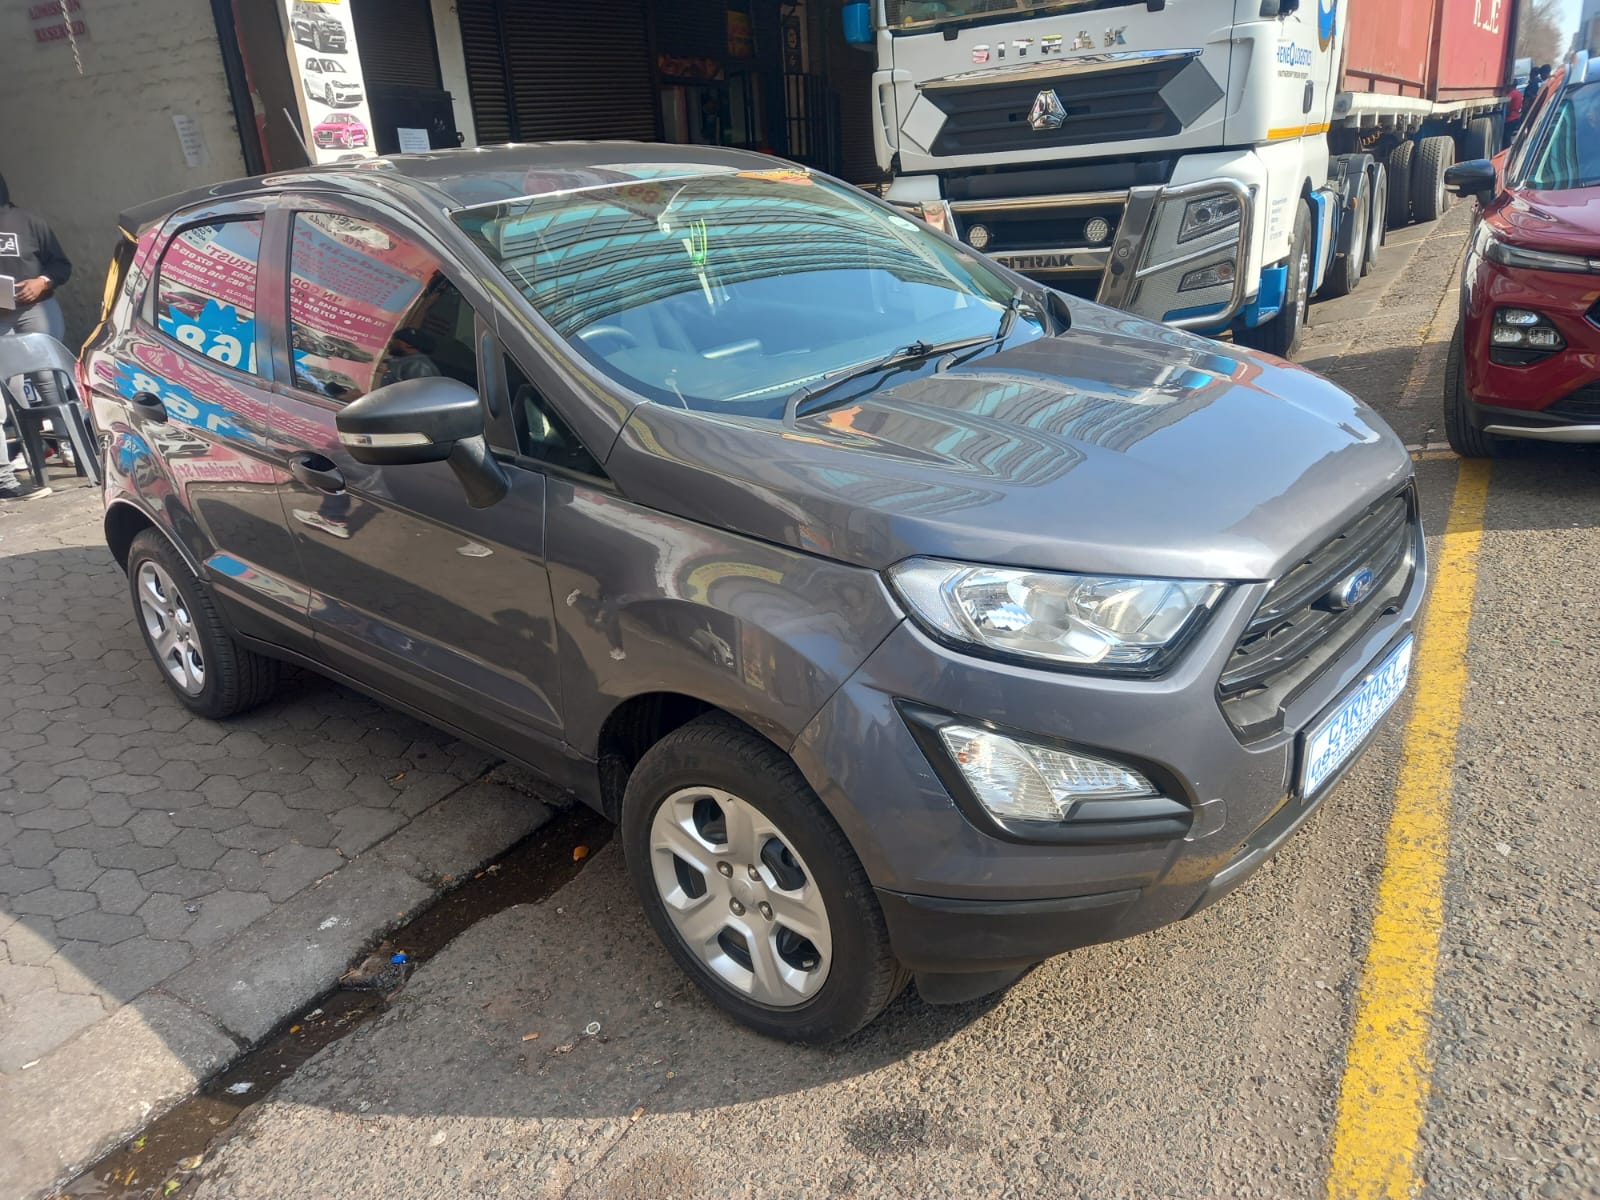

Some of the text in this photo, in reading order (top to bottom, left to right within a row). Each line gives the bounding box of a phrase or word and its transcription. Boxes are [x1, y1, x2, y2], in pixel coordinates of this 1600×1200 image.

[972, 25, 1128, 64] SITRAK
[996, 254, 1073, 269] SITRAK
[1328, 656, 1400, 746] CARMART
